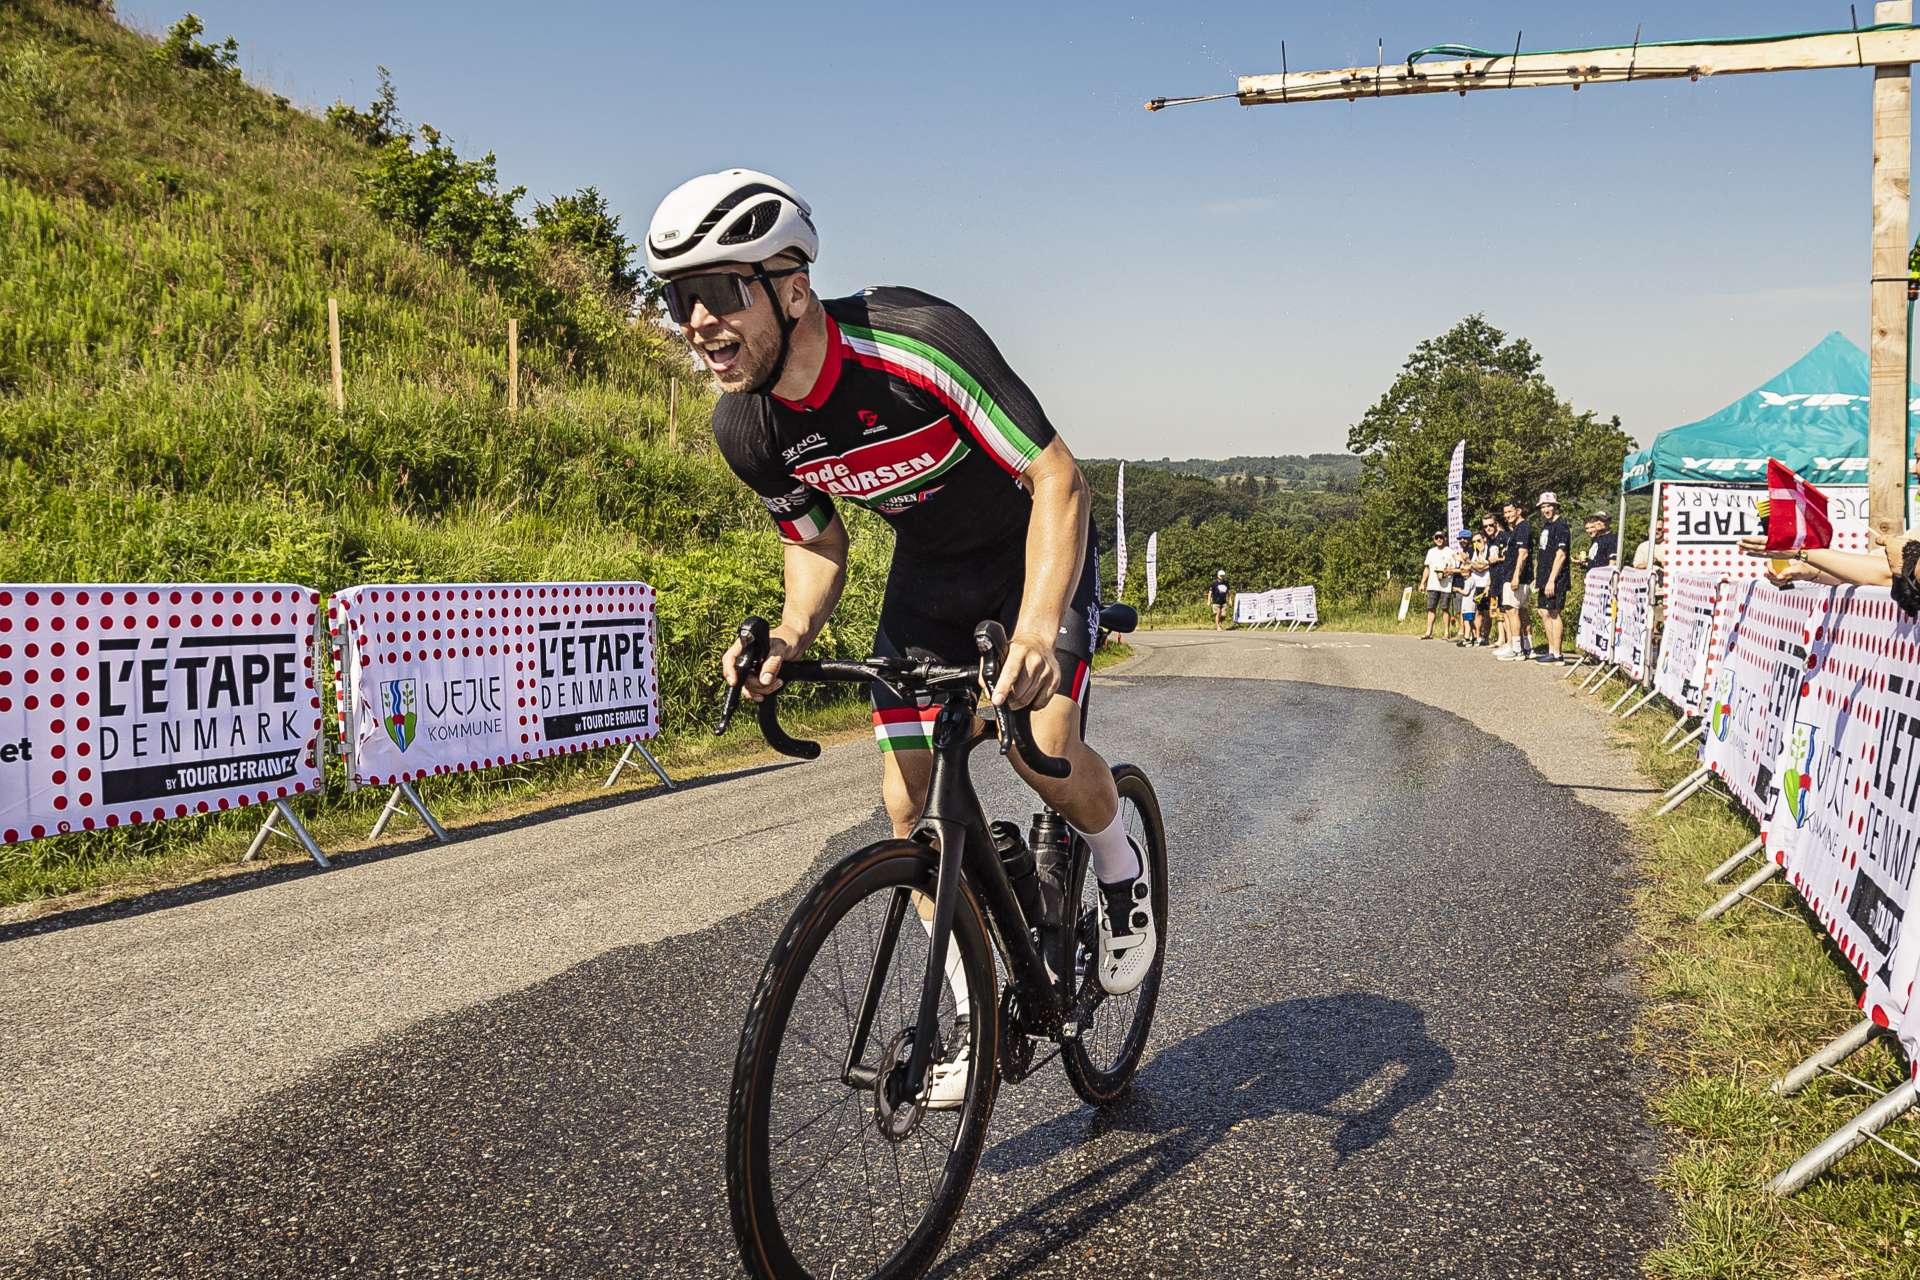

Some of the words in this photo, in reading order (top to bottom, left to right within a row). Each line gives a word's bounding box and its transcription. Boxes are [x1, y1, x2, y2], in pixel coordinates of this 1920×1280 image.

[1681, 457, 1785, 471] YET
[425, 676, 501, 718] VEJLE
[541, 675, 648, 709] DENMARK
[427, 718, 502, 741] KOMMUNE
[581, 713, 604, 731] TOUR
[604, 711, 615, 728] DE
[616, 708, 645, 725] FRANCE
[100, 710, 302, 760] DENMARK
[0, 737, 33, 763] et
[165, 778, 177, 790] BY
[177, 764, 219, 789] TOUR
[219, 762, 239, 783] DE
